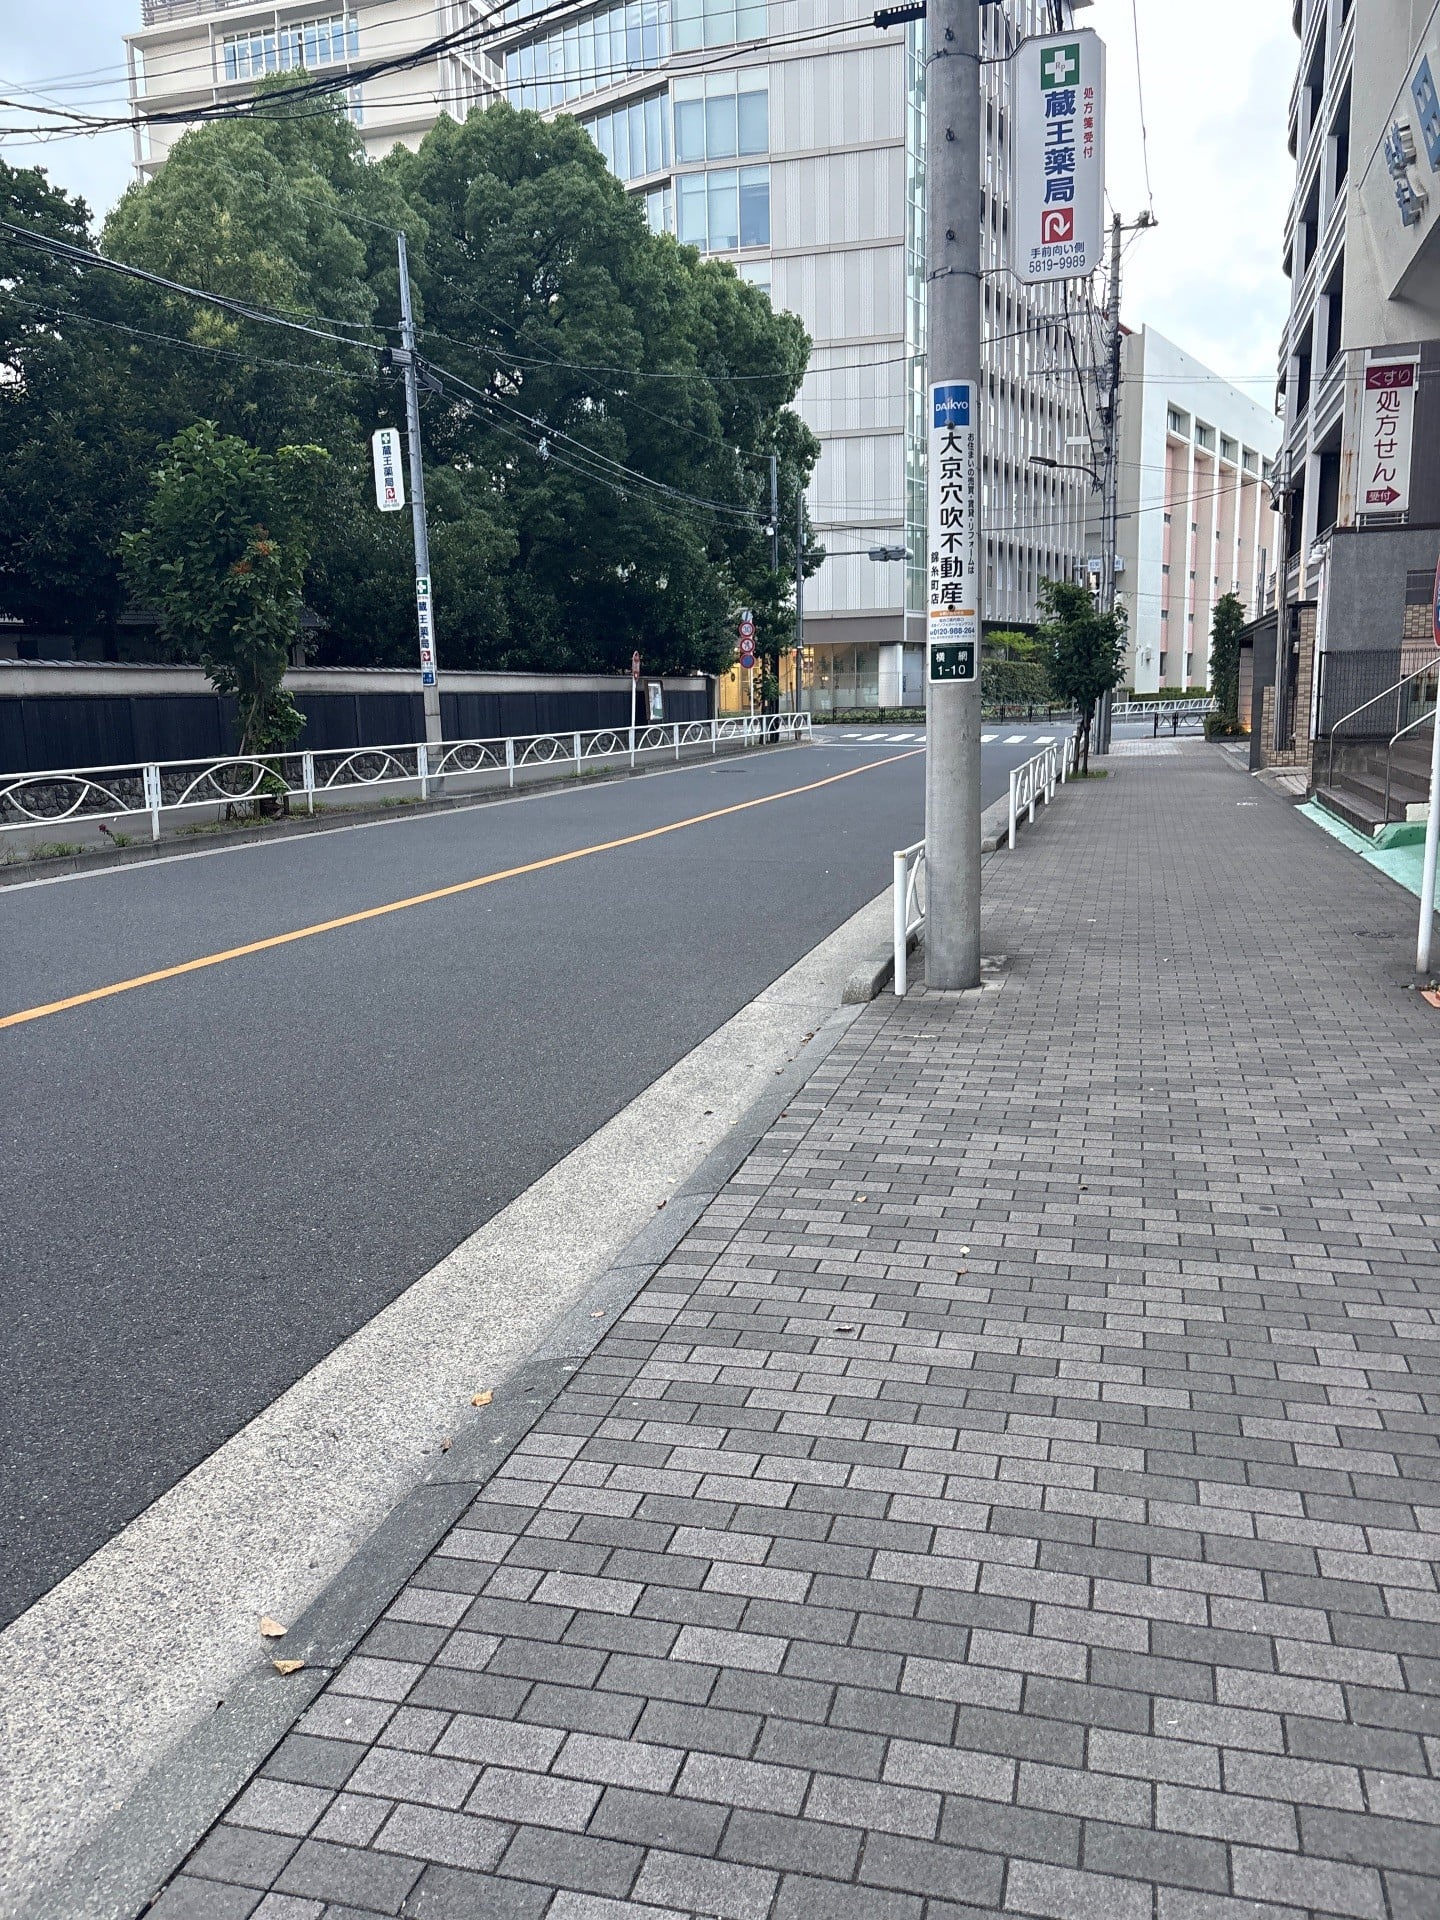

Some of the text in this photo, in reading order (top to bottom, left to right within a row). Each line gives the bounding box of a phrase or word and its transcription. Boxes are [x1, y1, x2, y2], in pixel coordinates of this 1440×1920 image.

[1055, 61, 1066, 72] Rp
[1083, 87, 1094, 159] 処方箋受付
[1044, 89, 1076, 204] 蔵王薬局
[1030, 241, 1085, 259] 手前向い側
[1028, 254, 1086, 274] 5819-9989
[1369, 369, 1410, 386] くすり
[1372, 390, 1401, 483] 処方せん
[1368, 490, 1392, 502] 受付
[940, 432, 964, 604] 大京穴吹不動産
[930, 551, 939, 605] 錦糸町店
[938, 664, 966, 676] 1-10
